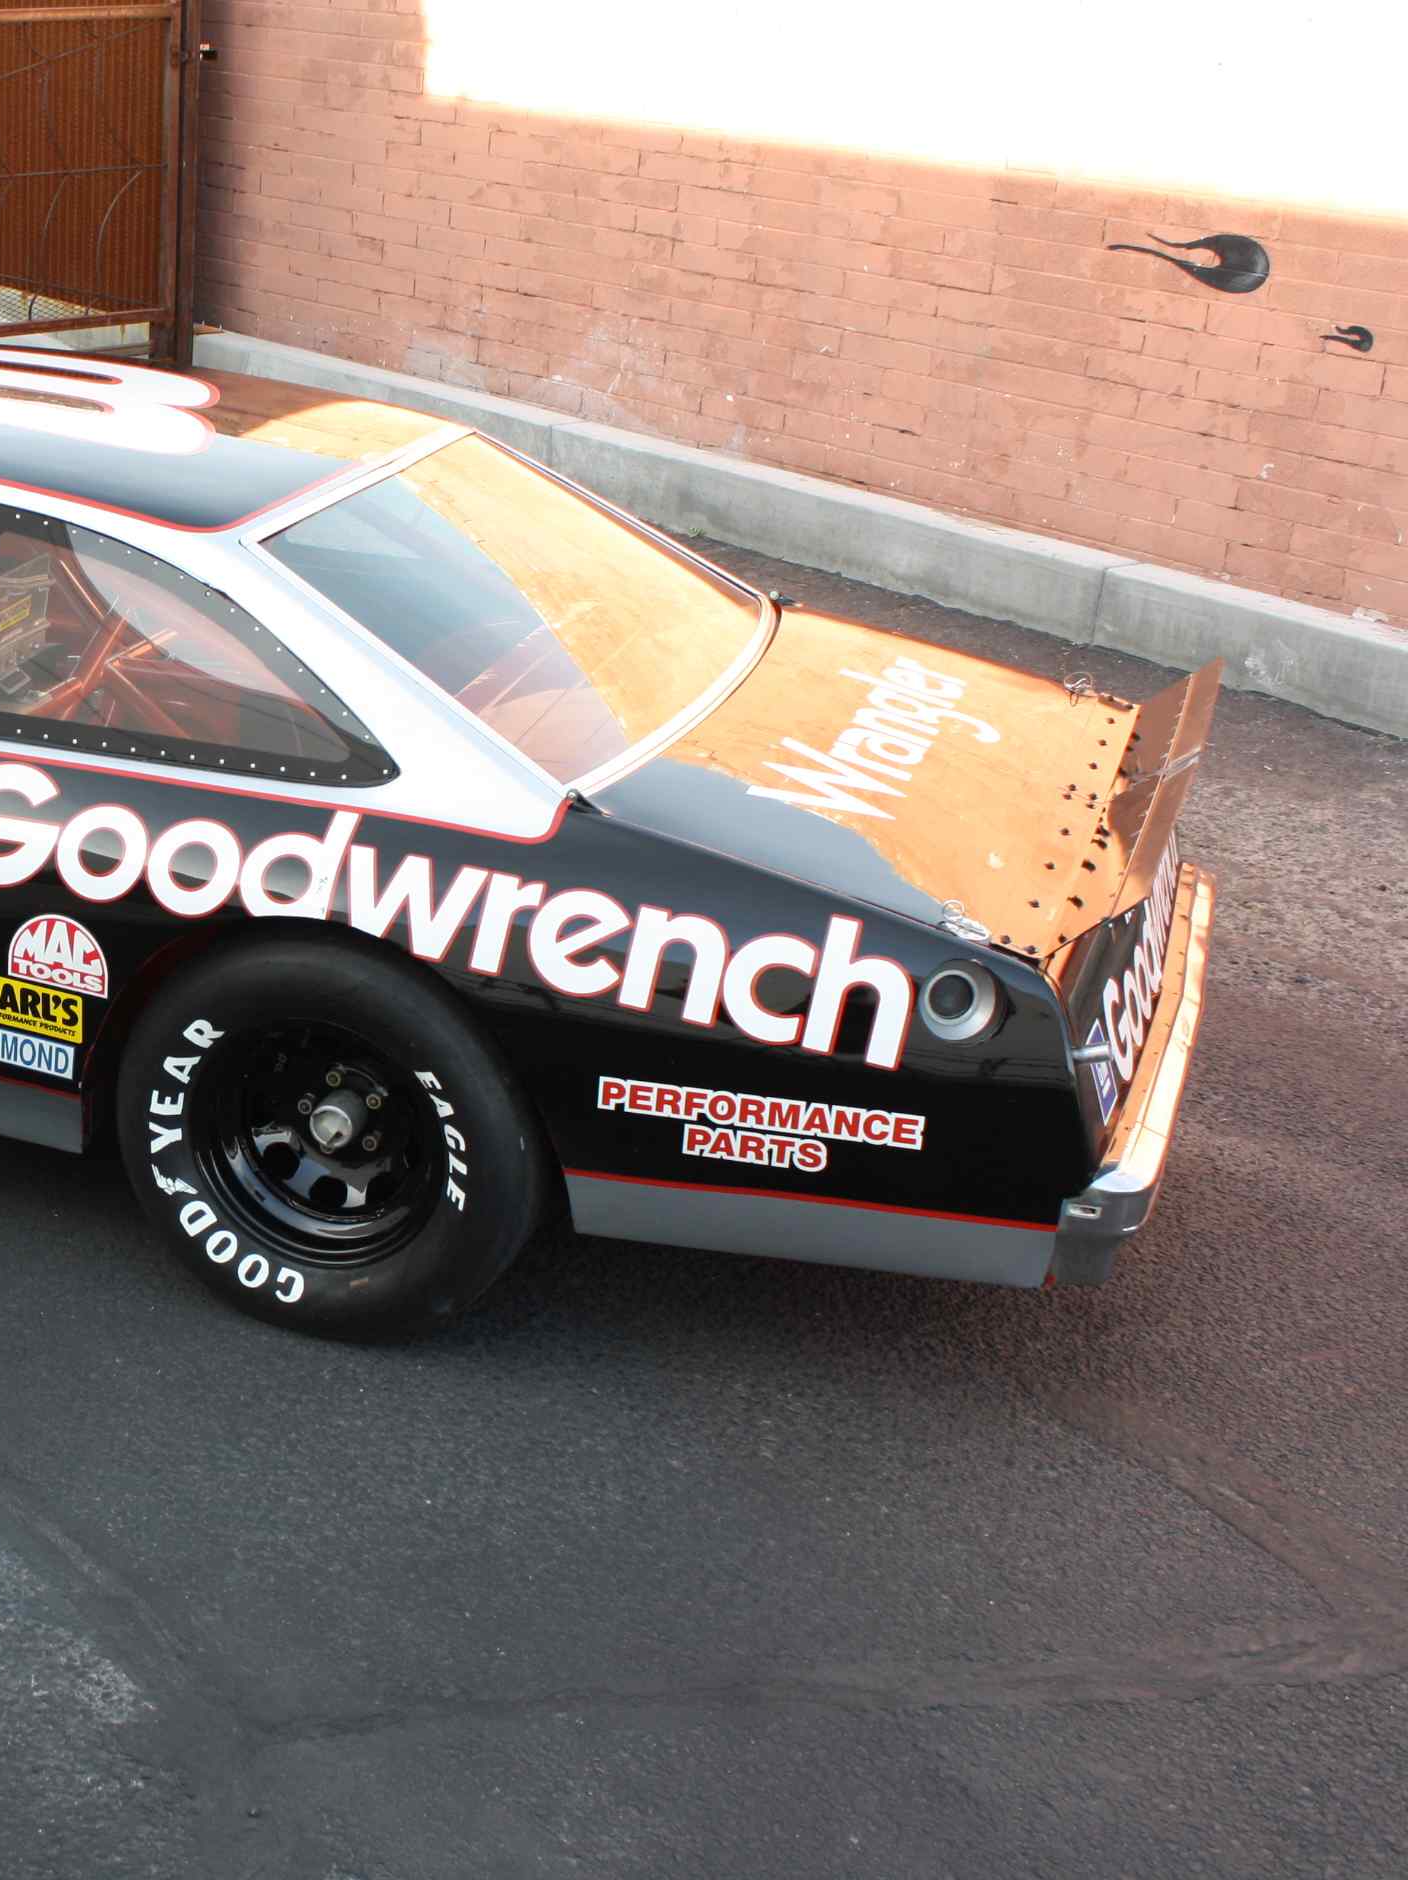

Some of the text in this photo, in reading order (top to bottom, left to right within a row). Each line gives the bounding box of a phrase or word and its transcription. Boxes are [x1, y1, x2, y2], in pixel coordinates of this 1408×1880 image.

[745, 655, 1001, 821] Wrangler
[13, 920, 102, 976] MAC
[13, 958, 104, 993] TOOLS
[38, 1021, 77, 1038] PRODUCTS
[414, 1070, 468, 1212] EAGLE
[598, 1077, 925, 1150] PERFORMANCE
[148, 1017, 305, 1304] GOODYEAR
[683, 1125, 828, 1173] PARTS
